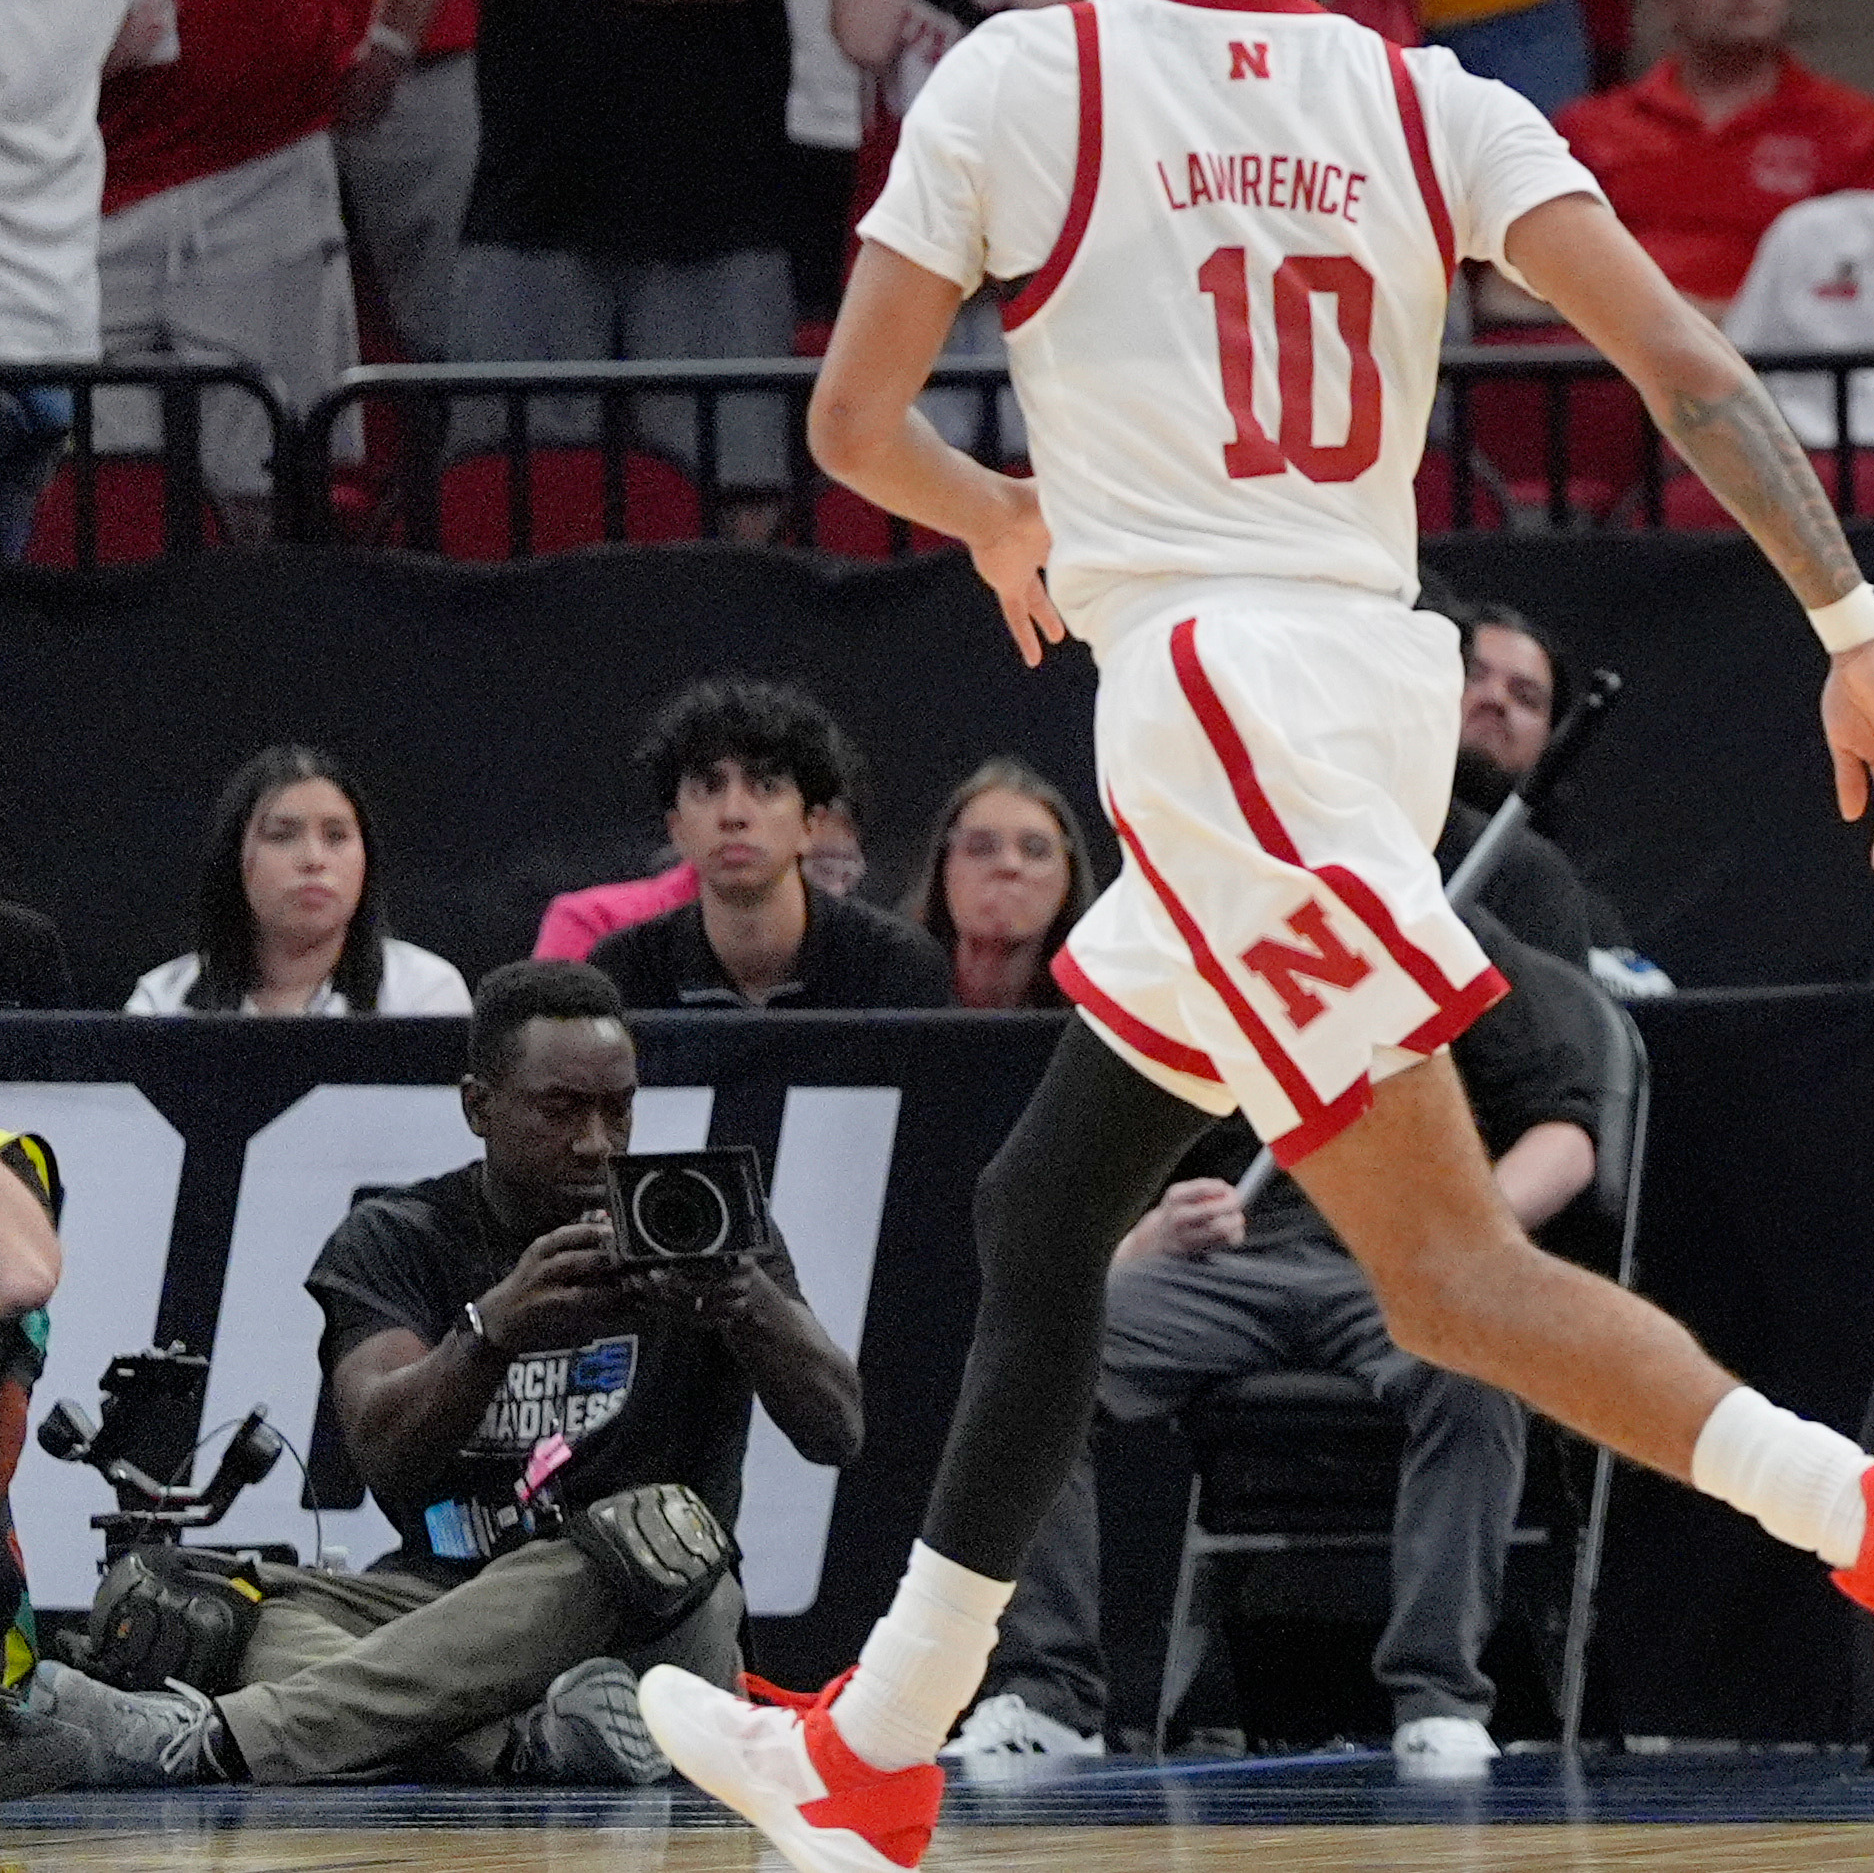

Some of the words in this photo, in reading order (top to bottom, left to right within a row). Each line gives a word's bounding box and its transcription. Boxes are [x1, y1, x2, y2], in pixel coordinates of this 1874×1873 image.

[1228, 40, 1271, 80] N
[1157, 151, 1368, 222] LAWRENCE
[1198, 247, 1383, 482] 10
[1237, 895, 1376, 1031] N
